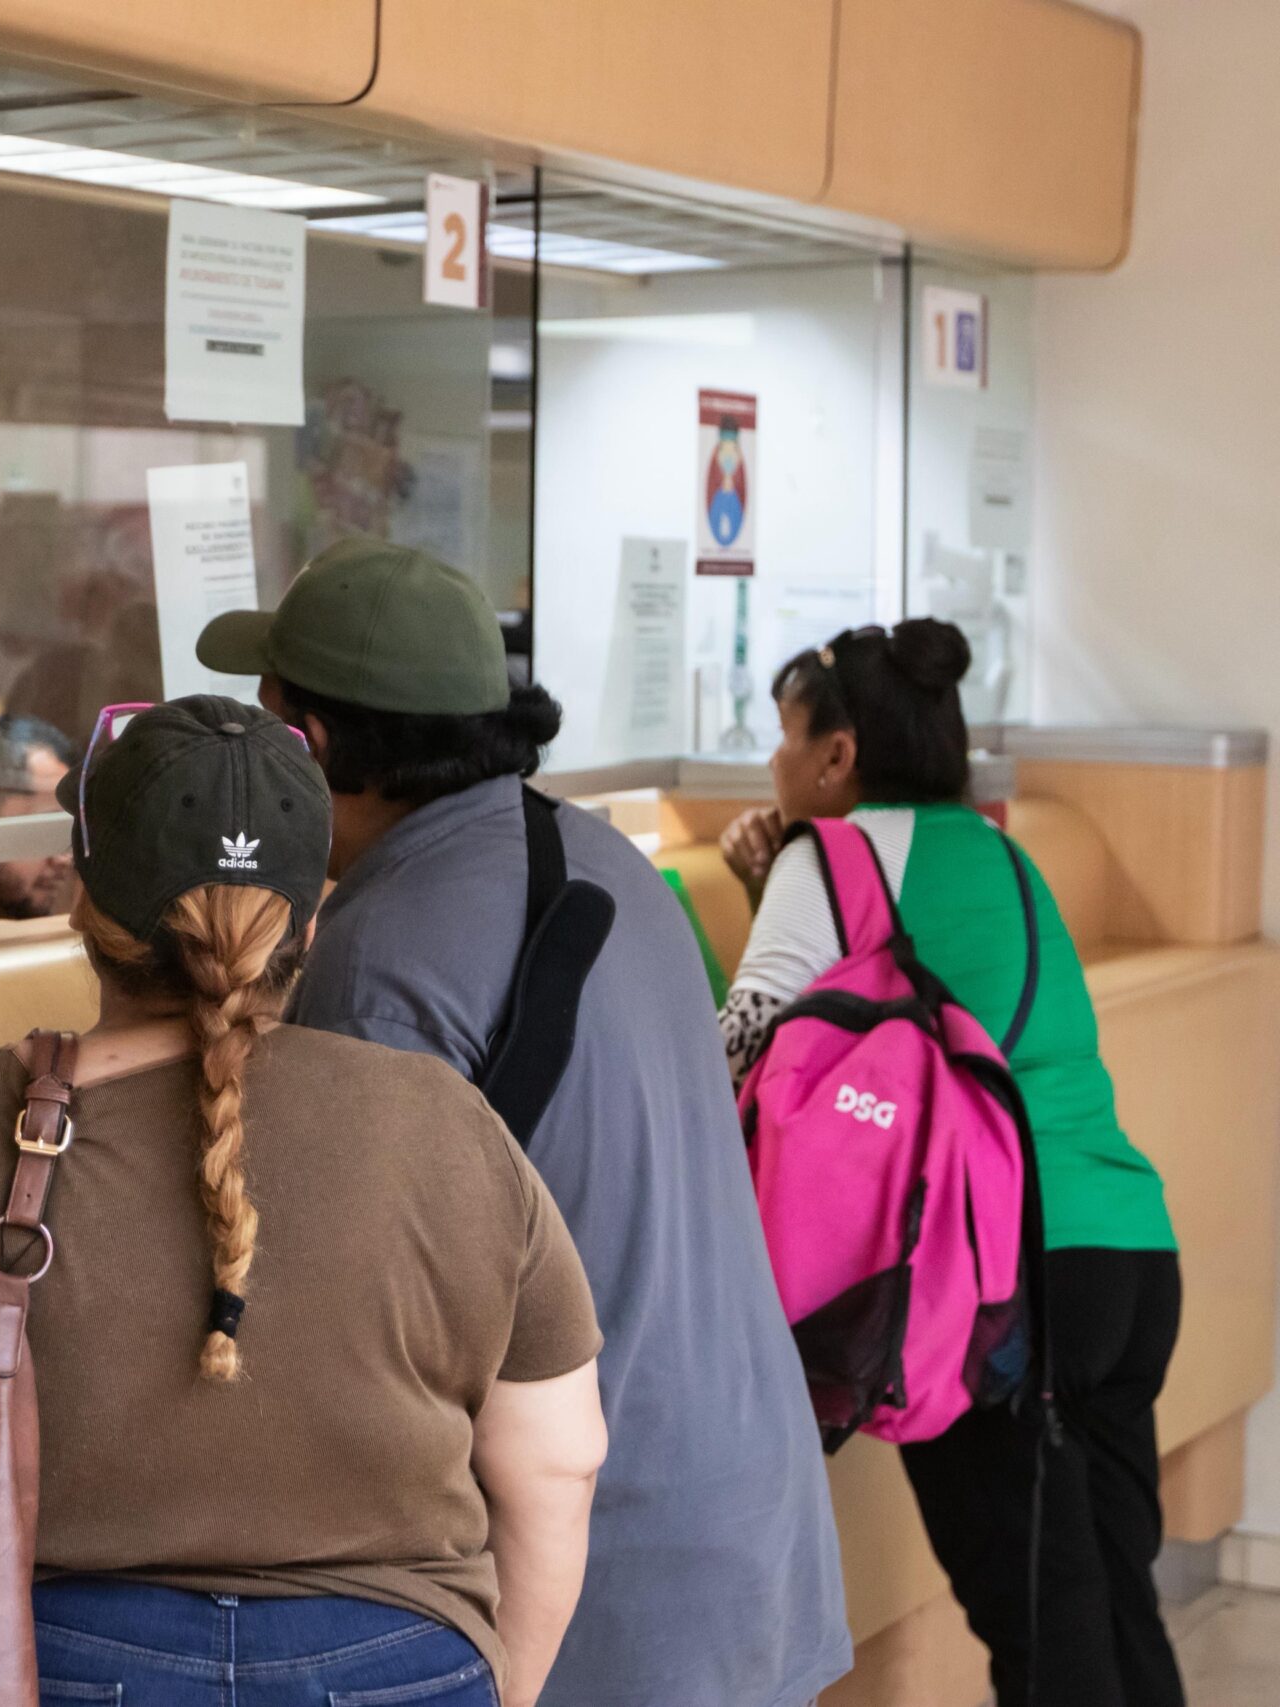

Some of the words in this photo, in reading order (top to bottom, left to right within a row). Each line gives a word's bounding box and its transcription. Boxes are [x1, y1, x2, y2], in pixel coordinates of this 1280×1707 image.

[441, 212, 466, 282] 2
[934, 312, 947, 369] 1
[218, 857, 258, 869] adidas
[834, 1083, 898, 1130] DSG
